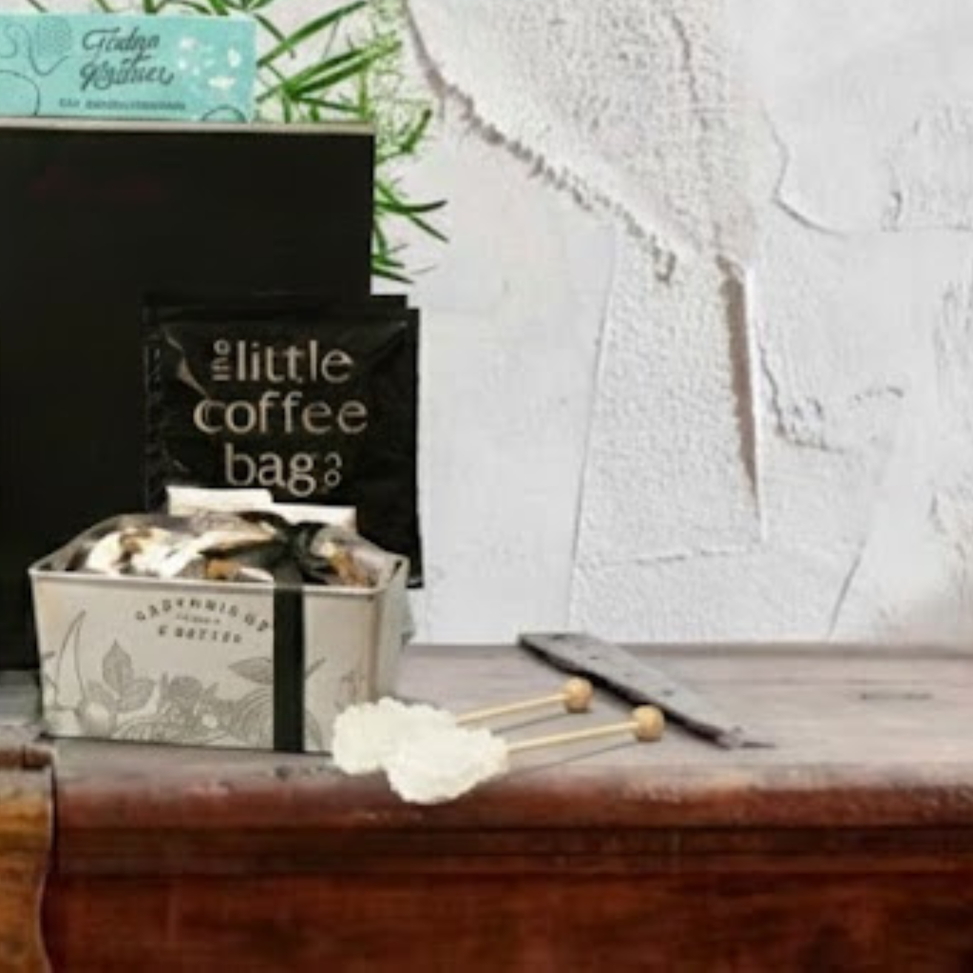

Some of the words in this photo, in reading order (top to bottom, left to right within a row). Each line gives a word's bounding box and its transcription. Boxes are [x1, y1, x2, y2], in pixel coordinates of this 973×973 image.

[236, 339, 354, 383] little
[193, 391, 368, 434] coffee
[224, 443, 317, 497] bag
